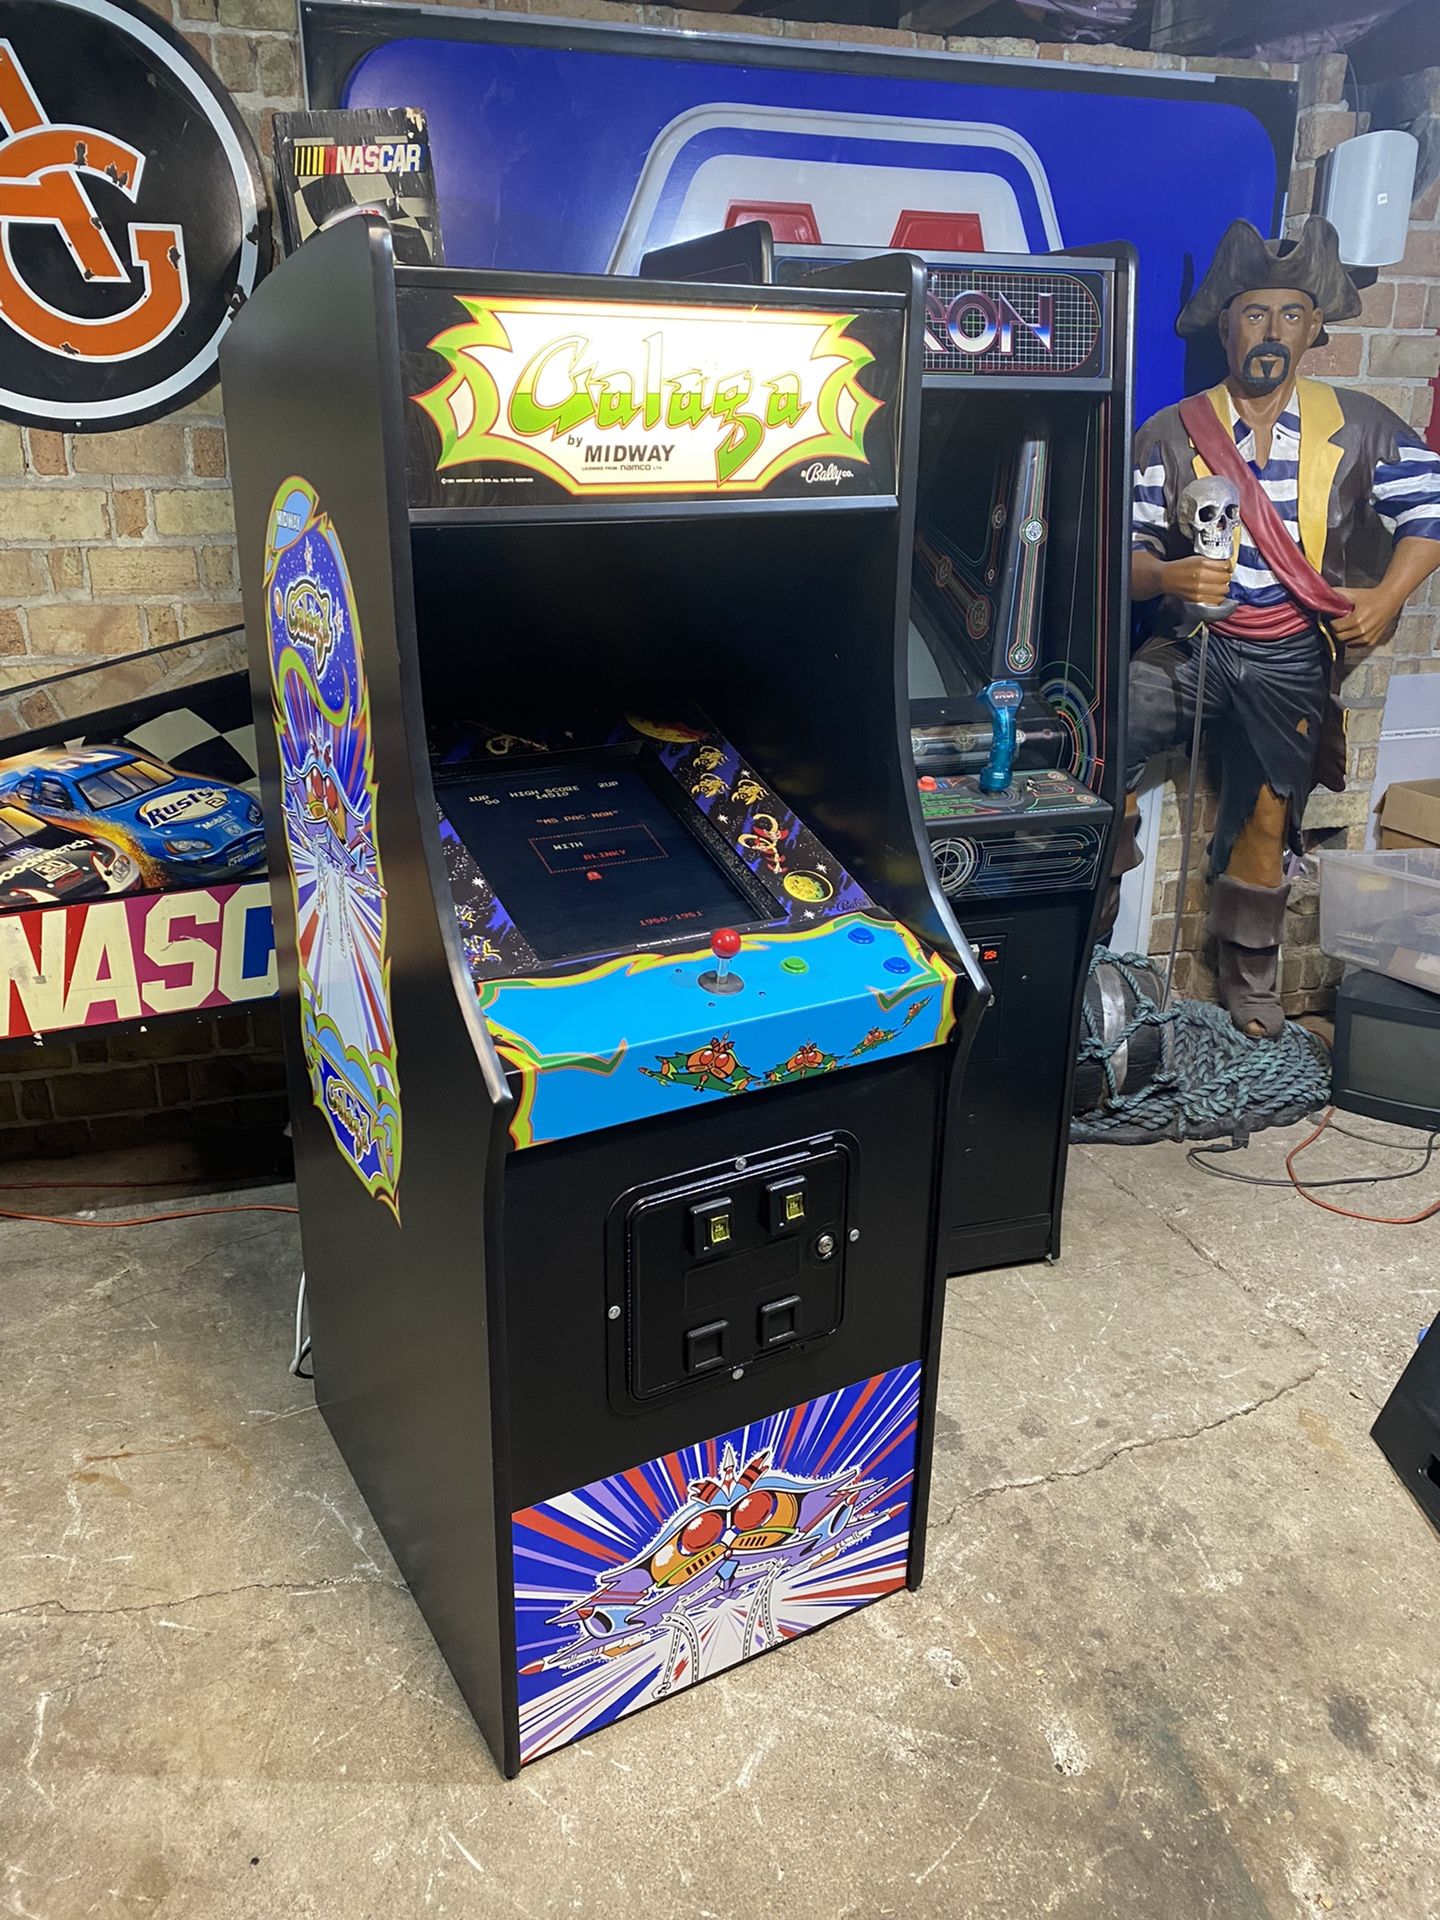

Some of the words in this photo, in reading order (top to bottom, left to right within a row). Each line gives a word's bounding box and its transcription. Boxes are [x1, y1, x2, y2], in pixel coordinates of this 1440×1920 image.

[335, 144, 421, 175] NASCAR
[508, 331, 812, 487] Galaga
[567, 434, 583, 447] by
[585, 444, 675, 462] MIDWAY
[805, 462, 841, 486] Bally
[468, 794, 489, 803] 1UP
[508, 789, 540, 798] HIGH
[544, 785, 580, 795] SCORE
[597, 780, 619, 788] 2UP
[146, 786, 214, 829] Rusty
[552, 841, 584, 850] WITH
[582, 849, 626, 861] BLINKY
[0, 839, 93, 886] oodwrench
